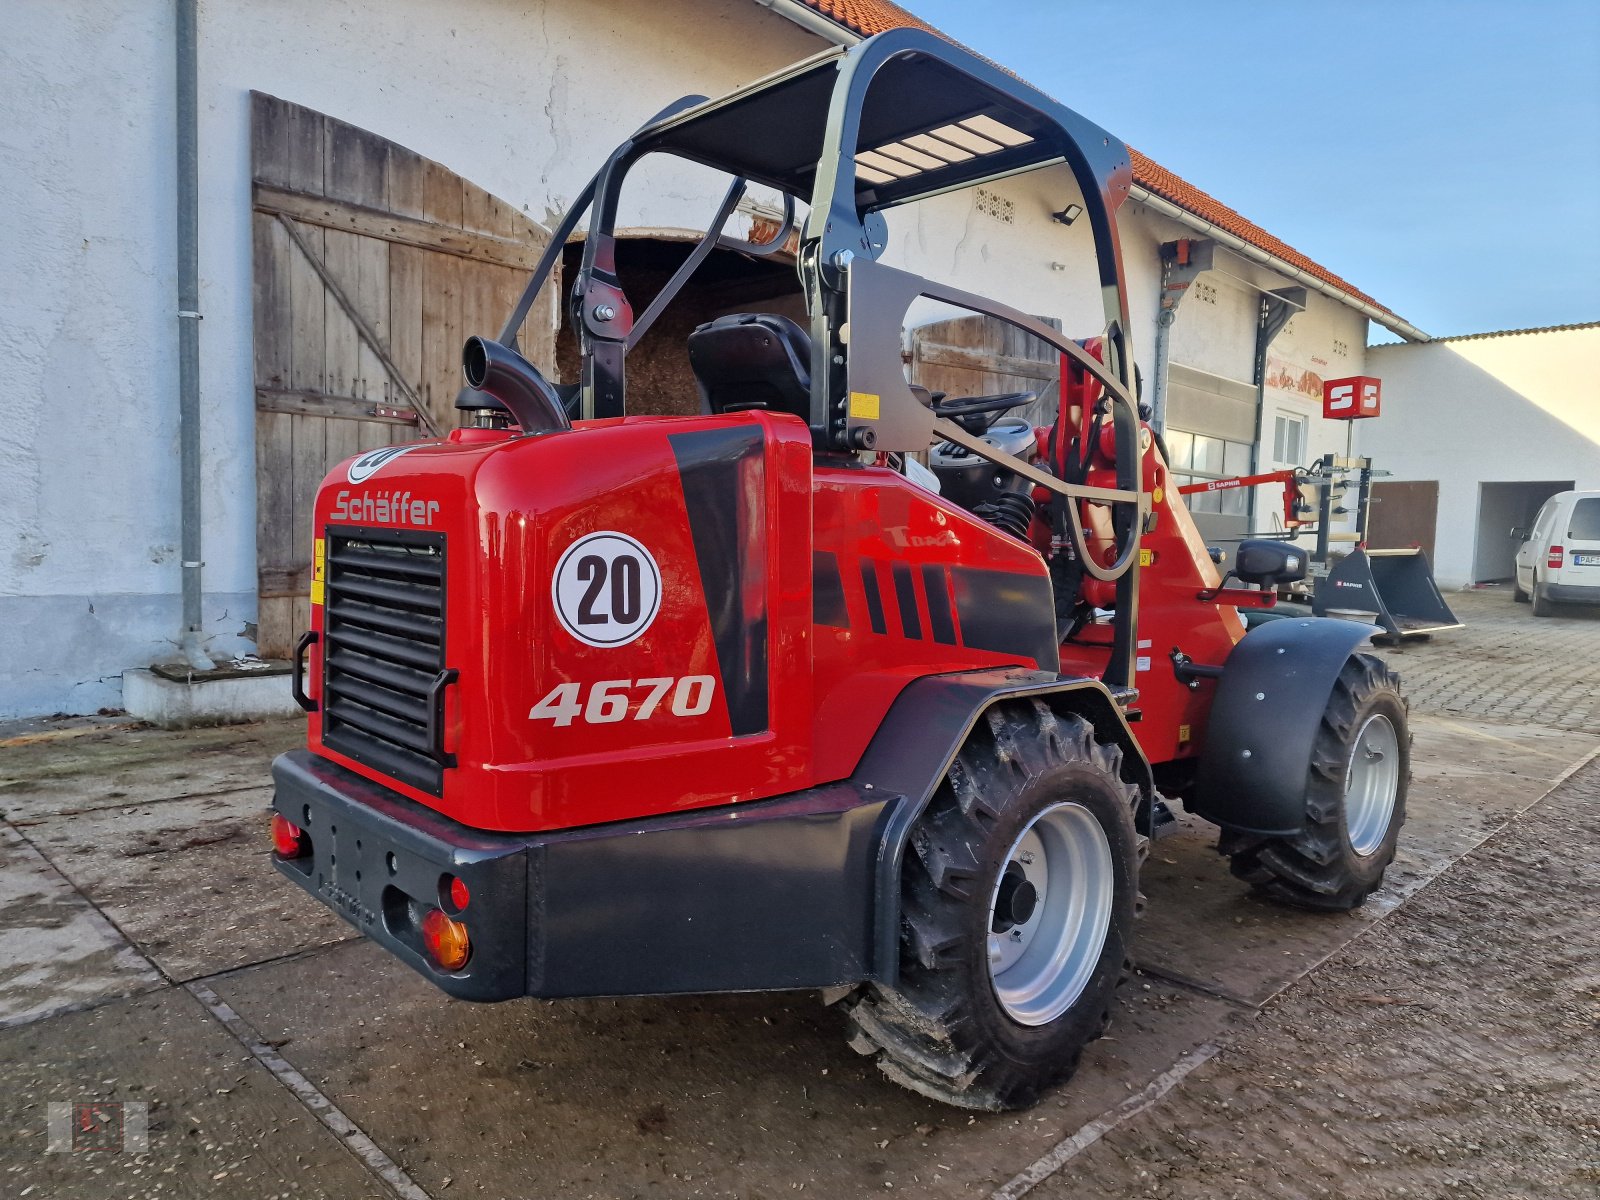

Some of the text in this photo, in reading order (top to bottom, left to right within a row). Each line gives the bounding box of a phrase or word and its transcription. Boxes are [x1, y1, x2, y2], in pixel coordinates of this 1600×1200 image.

[1216, 480, 1240, 488] SAPHIR
[330, 490, 440, 525] Schäffer
[577, 555, 641, 625] 20
[528, 674, 716, 728] 4670
